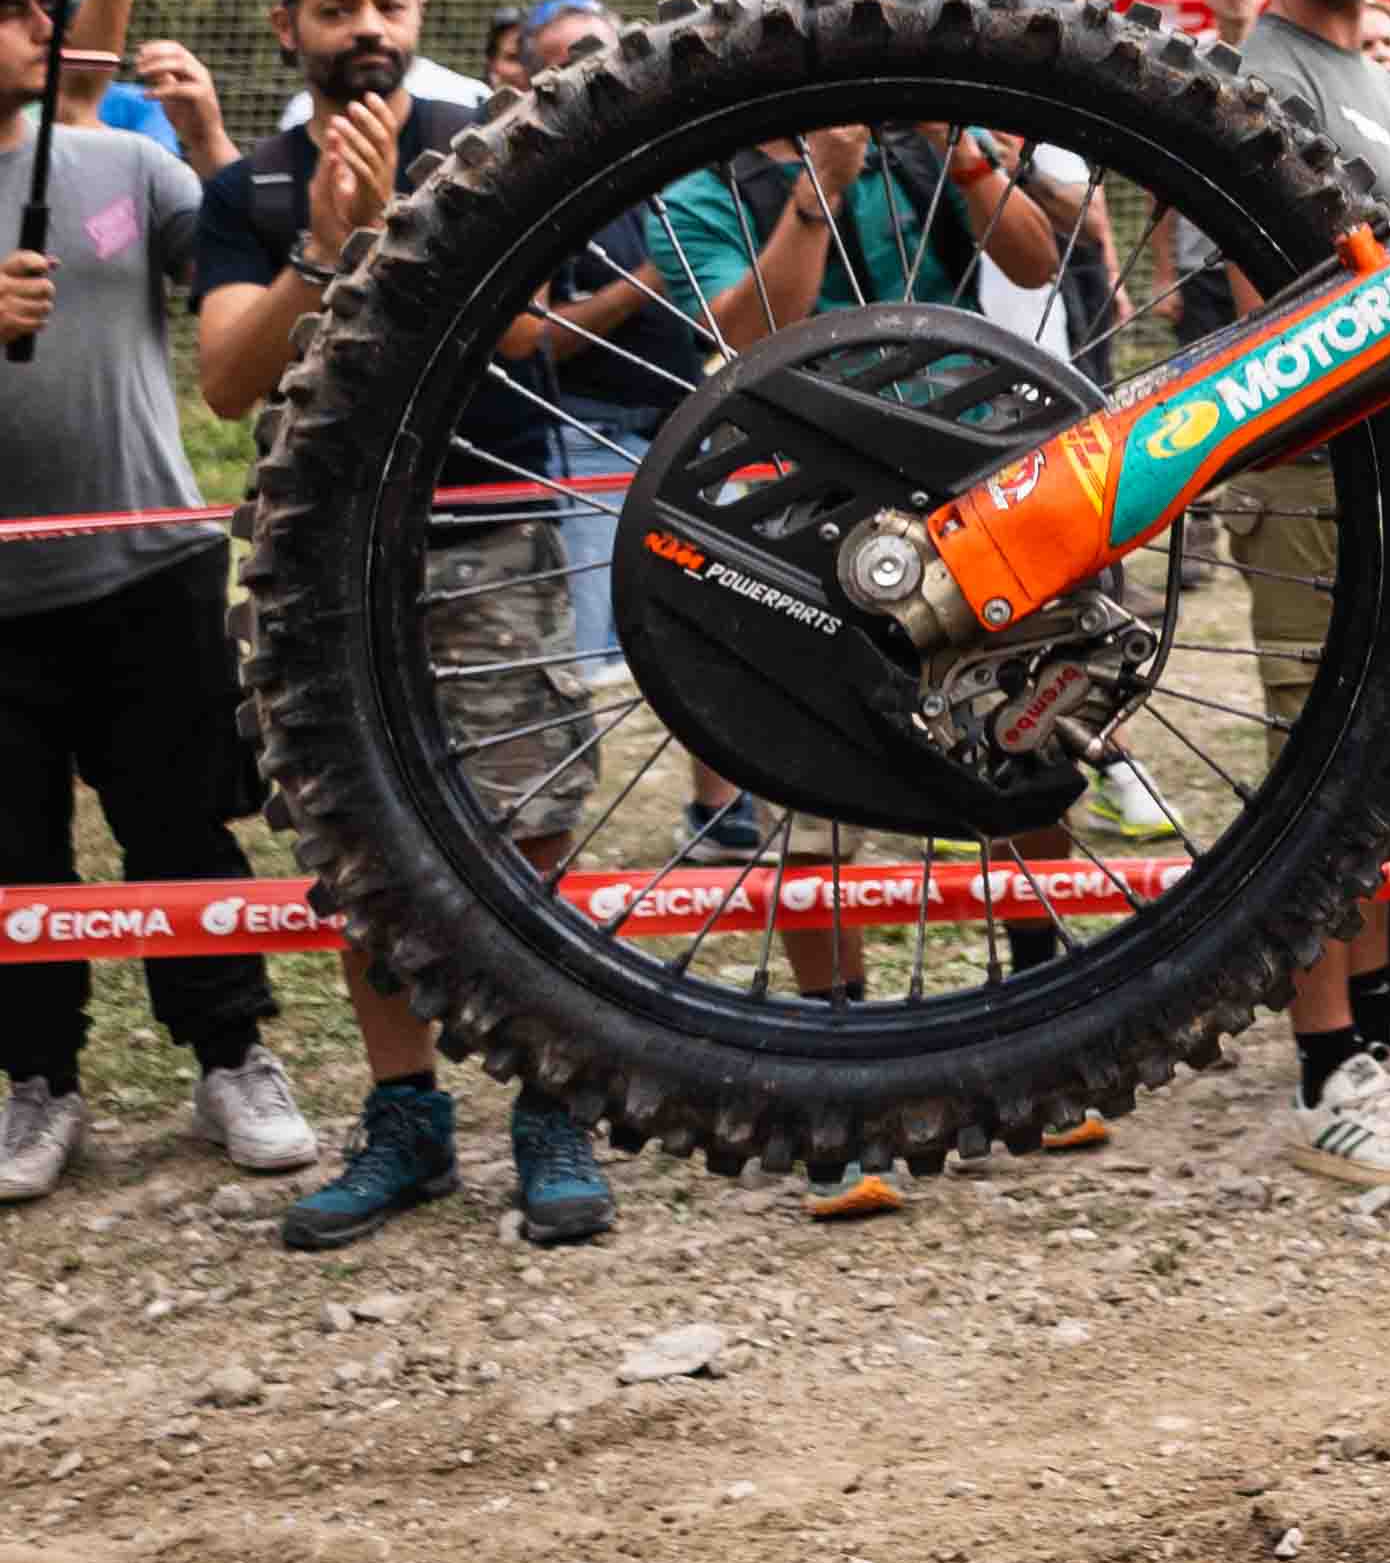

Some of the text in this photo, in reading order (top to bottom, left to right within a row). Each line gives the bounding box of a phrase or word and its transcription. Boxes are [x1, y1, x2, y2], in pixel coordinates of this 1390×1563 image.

[705, 562, 843, 635] POWERPARTS
[629, 885, 754, 918] EICMA
[822, 876, 945, 908] EICMA
[1012, 870, 1128, 902] EICMA
[50, 907, 175, 941] EICMA
